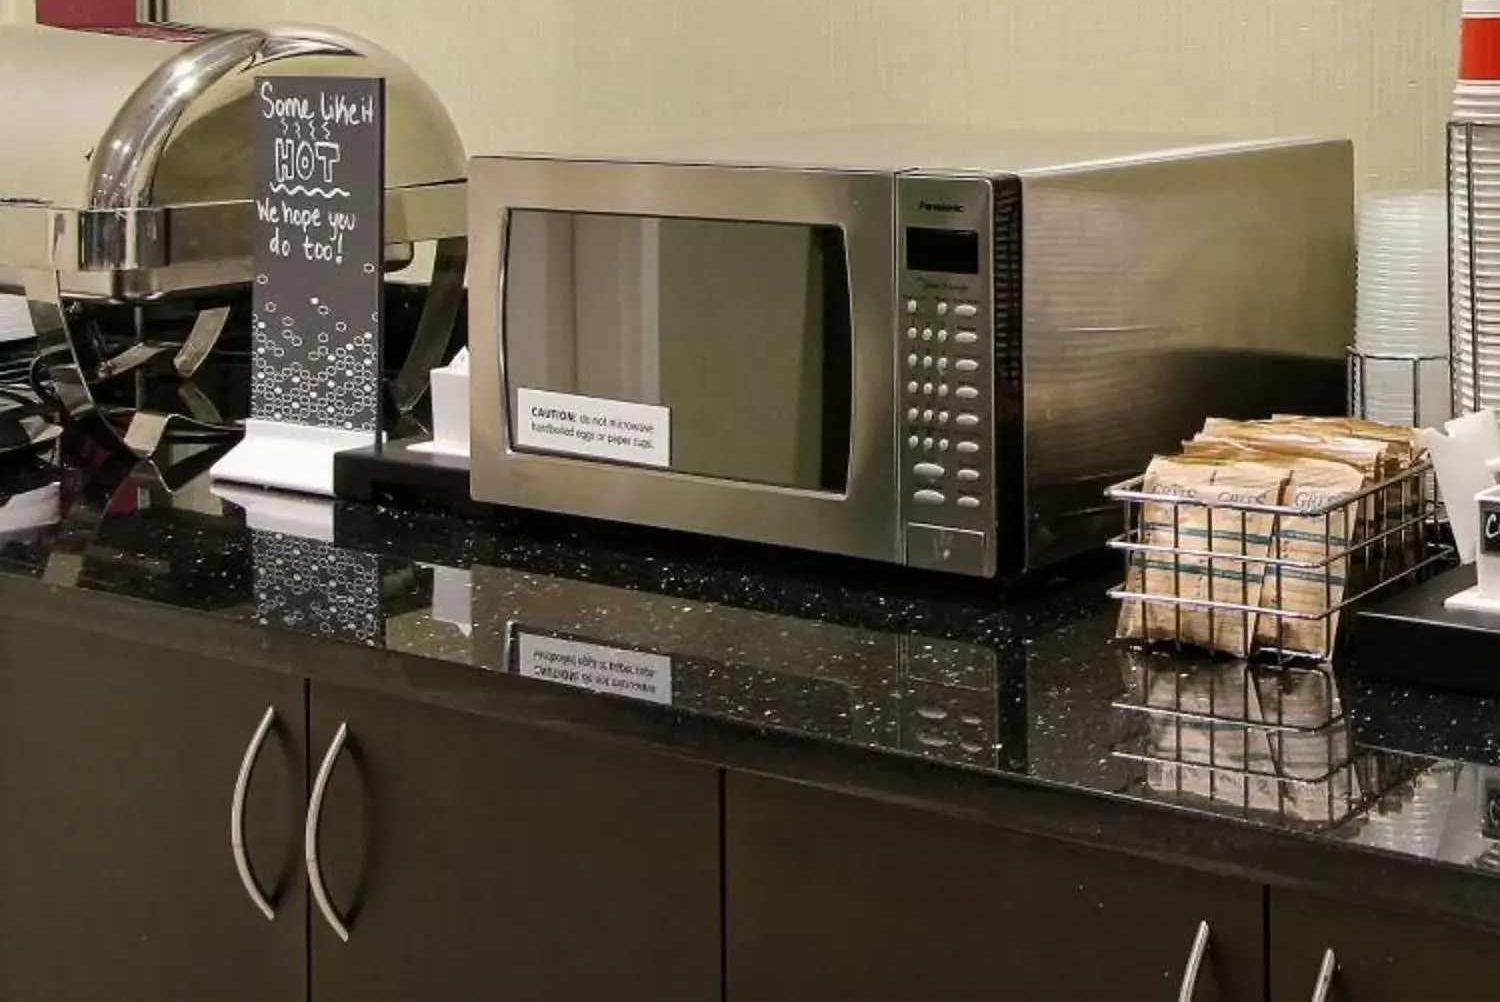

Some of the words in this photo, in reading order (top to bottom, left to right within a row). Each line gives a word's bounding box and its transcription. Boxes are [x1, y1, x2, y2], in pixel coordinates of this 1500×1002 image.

[260, 81, 315, 119] Some
[320, 91, 360, 125] like
[361, 95, 374, 124] it
[275, 137, 341, 183] HOT
[256, 197, 280, 223] We
[281, 199, 322, 232] hope
[327, 210, 357, 241] you
[269, 226, 291, 257] do
[302, 232, 344, 264] too!
[531, 406, 577, 423] CAUTION:
